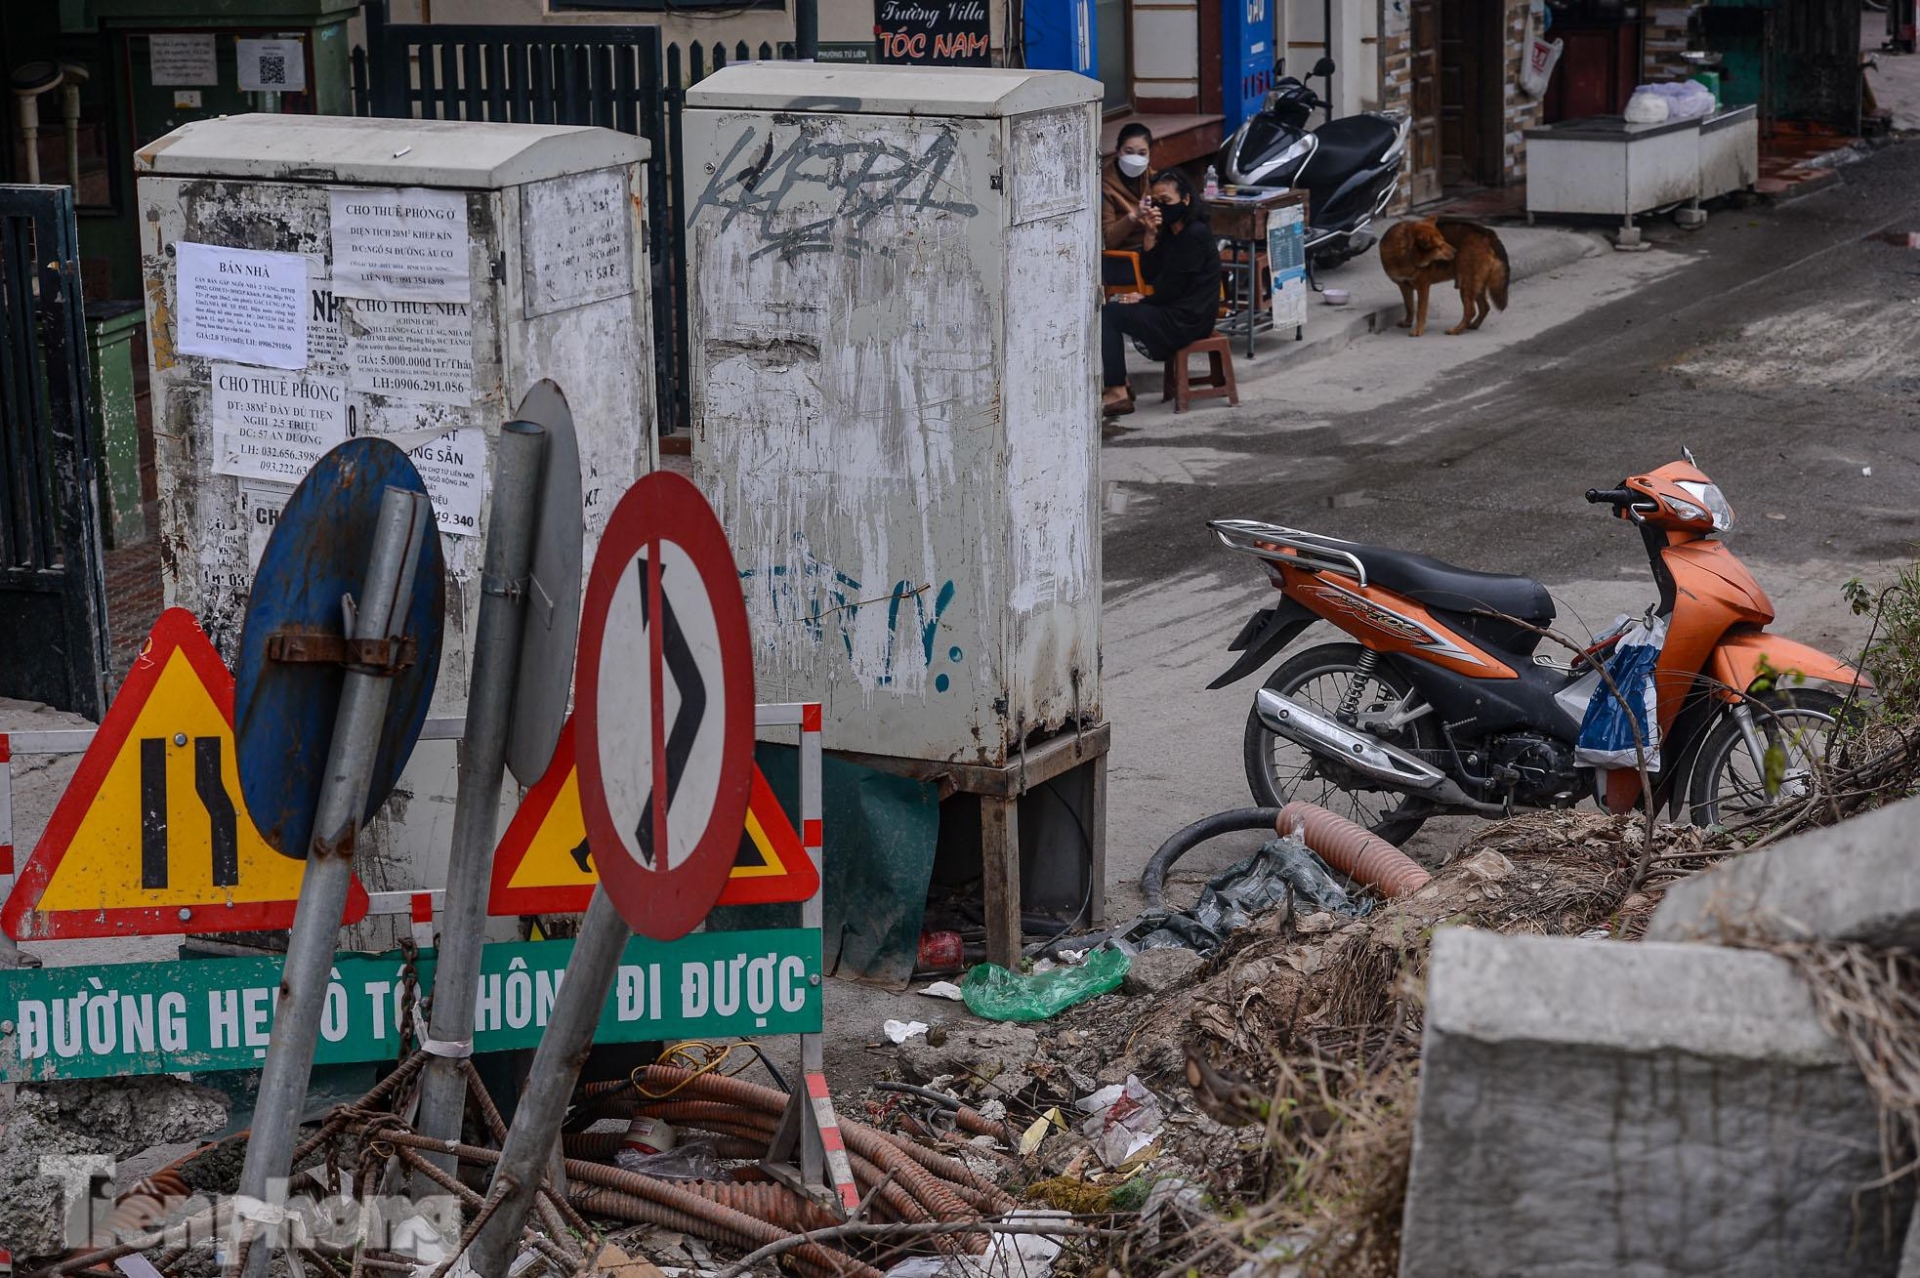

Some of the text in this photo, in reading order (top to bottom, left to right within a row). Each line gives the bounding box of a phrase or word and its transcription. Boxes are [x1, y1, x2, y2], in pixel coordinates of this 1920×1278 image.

[948, 1, 985, 20] Villa
[879, 25, 989, 59] TÓC NAM
[345, 204, 371, 216] CHO
[372, 204, 402, 217] THUÊ
[405, 205, 444, 220] PHÒNG
[219, 260, 270, 278] BÁN NHÀ
[356, 299, 387, 313] CHO
[357, 353, 378, 365] GIÁ:
[219, 375, 339, 402] CHO THUÊ PHÒNG
[373, 376, 465, 394] LH:0906.291.056
[287, 420, 318, 434] TRIỆU
[258, 430, 268, 439] 57
[271, 431, 283, 440] AN
[285, 431, 322, 445] DƯƠNG
[240, 444, 259, 455] LH:
[437, 445, 464, 465] SẴN
[16, 976, 188, 1061] ĐƯỜNG
[207, 985, 283, 1059] HẸ
[615, 963, 661, 1023] ĐI
[680, 952, 805, 1028] ĐƯỢC
